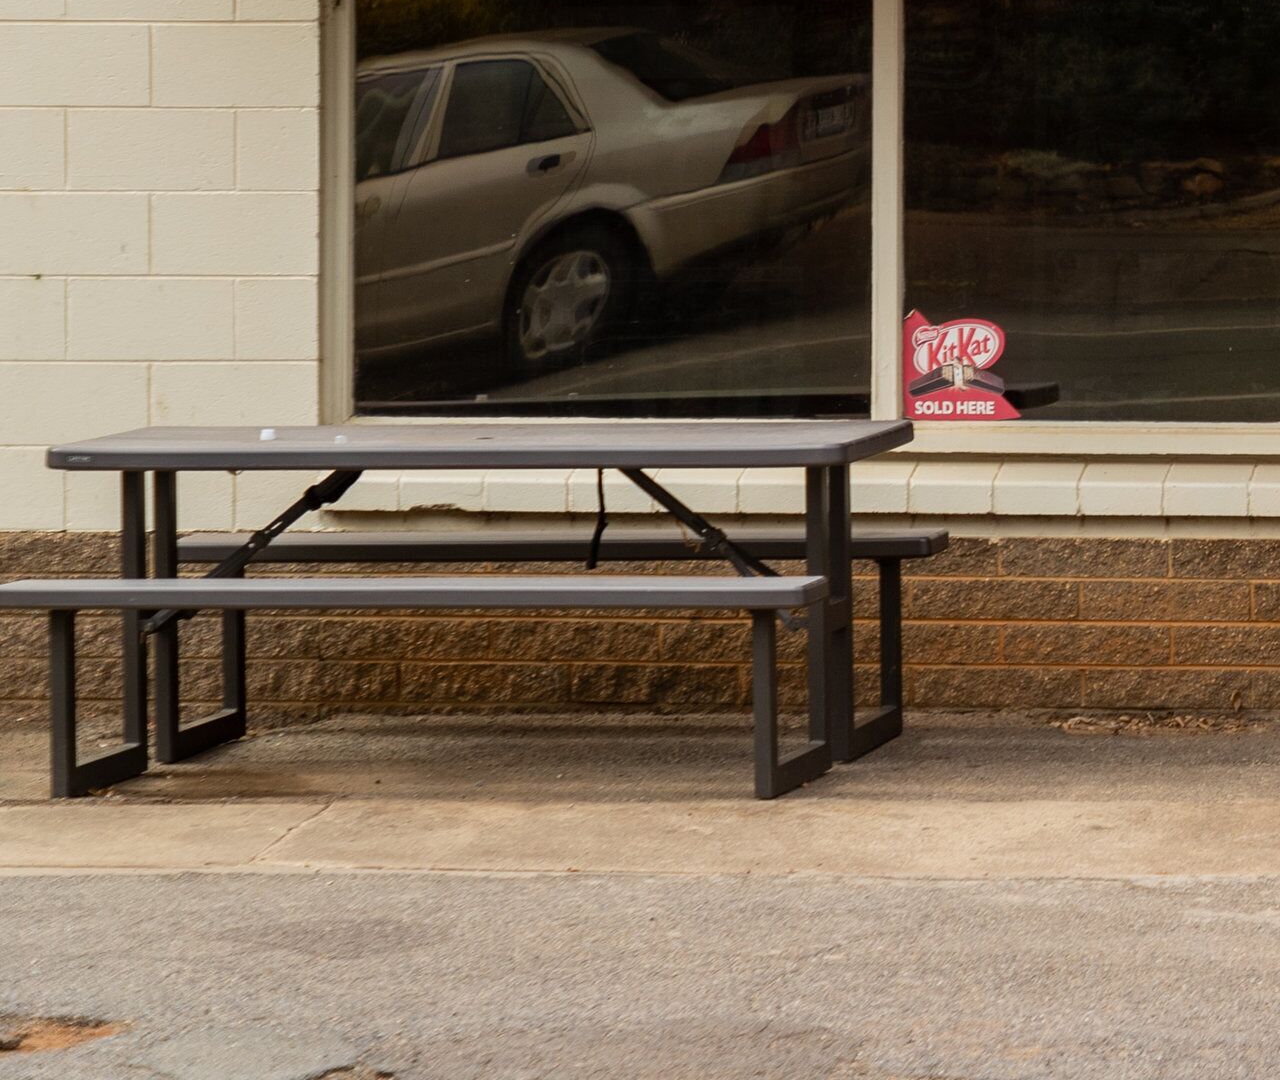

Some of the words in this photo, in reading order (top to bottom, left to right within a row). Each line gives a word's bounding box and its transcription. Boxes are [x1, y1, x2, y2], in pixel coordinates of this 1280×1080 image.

[927, 327, 991, 371] KitKat
[914, 400, 954, 415] SOLD
[956, 400, 995, 415] HERE
